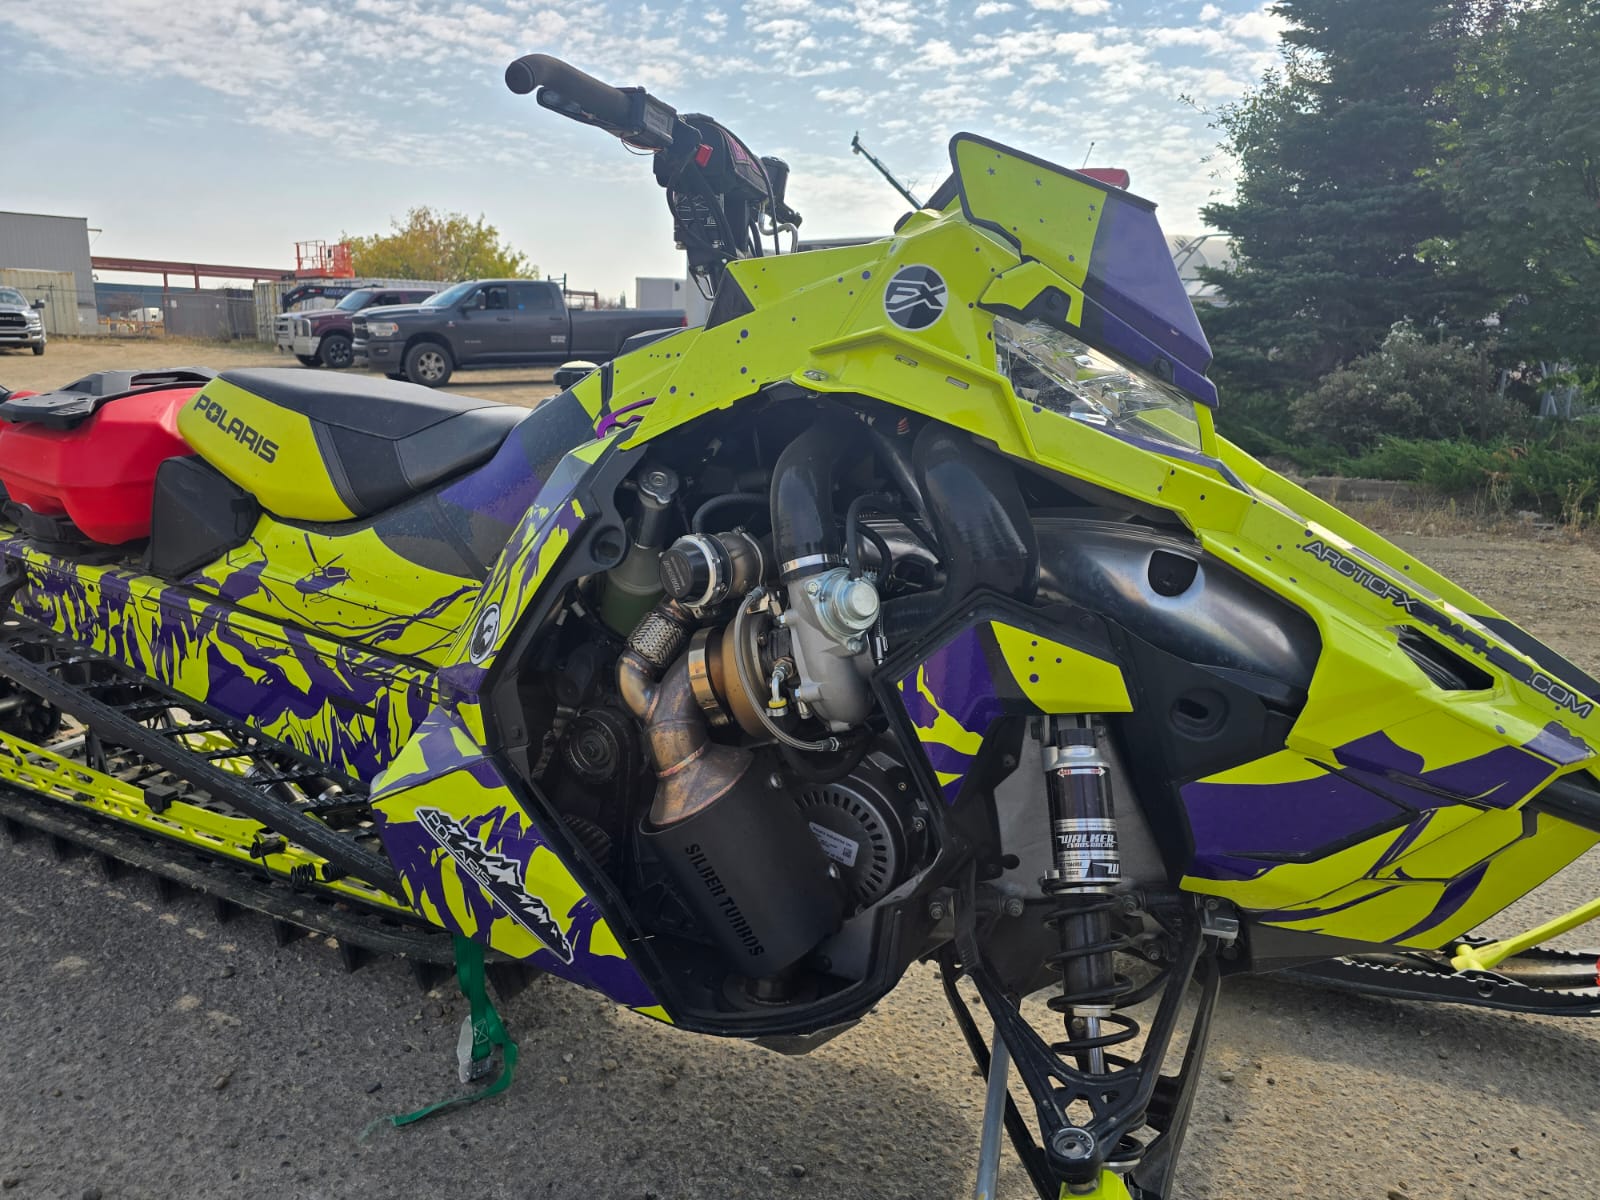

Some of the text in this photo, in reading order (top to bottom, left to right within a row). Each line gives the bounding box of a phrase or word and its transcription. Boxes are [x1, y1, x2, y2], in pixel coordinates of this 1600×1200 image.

[193, 394, 280, 464] POLARIS
[426, 811, 493, 885] POLARIS
[1057, 833, 1117, 844] WALKER
[685, 844, 765, 956] SILBER TURBOS
